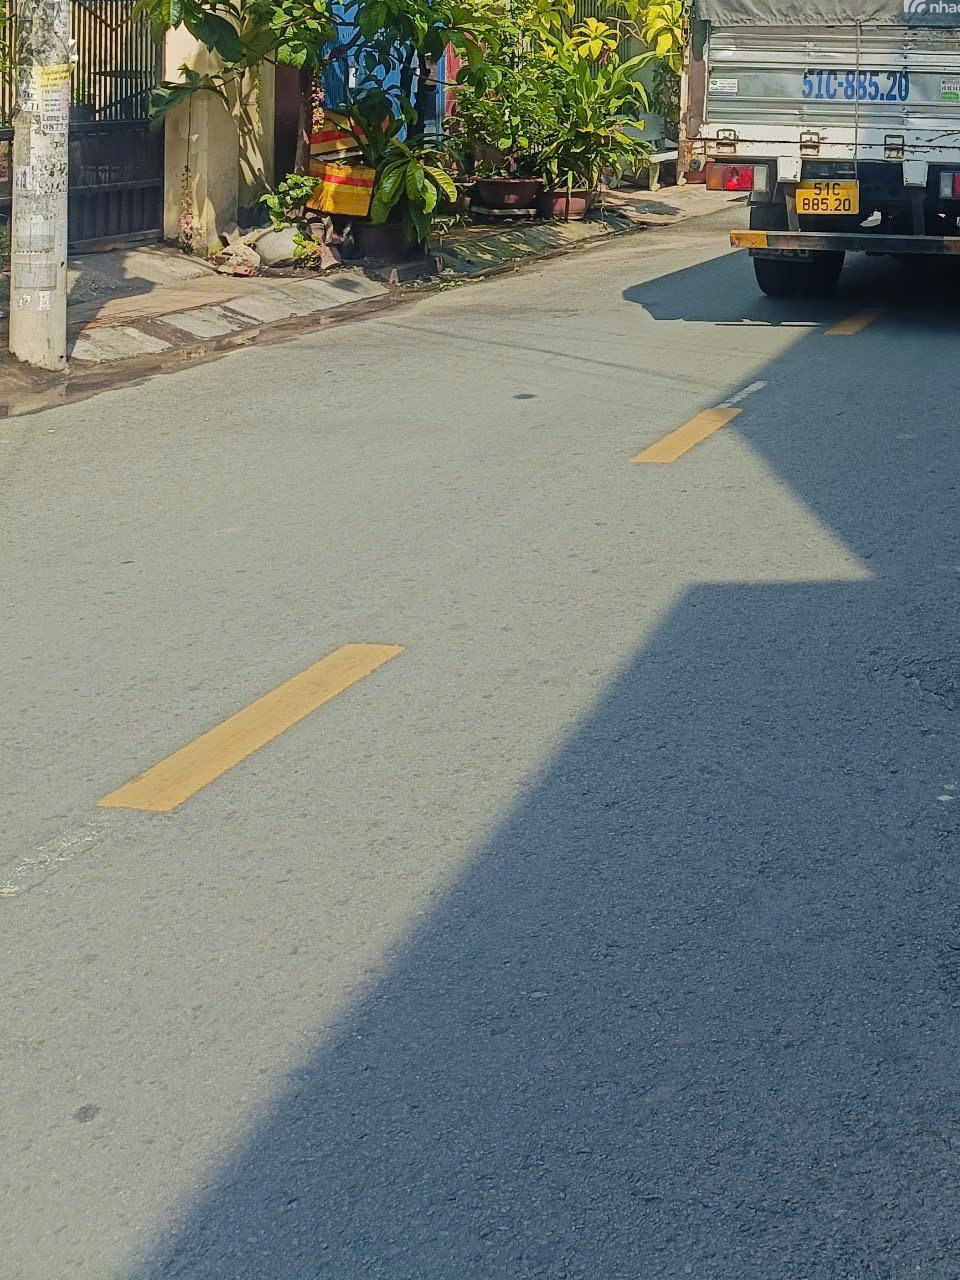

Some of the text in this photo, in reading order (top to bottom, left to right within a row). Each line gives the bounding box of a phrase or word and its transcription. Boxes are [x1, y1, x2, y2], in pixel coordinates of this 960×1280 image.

[802, 70, 909, 101] 51C-885.20
[814, 182, 841, 196] 51C
[802, 197, 851, 211] 885.20
